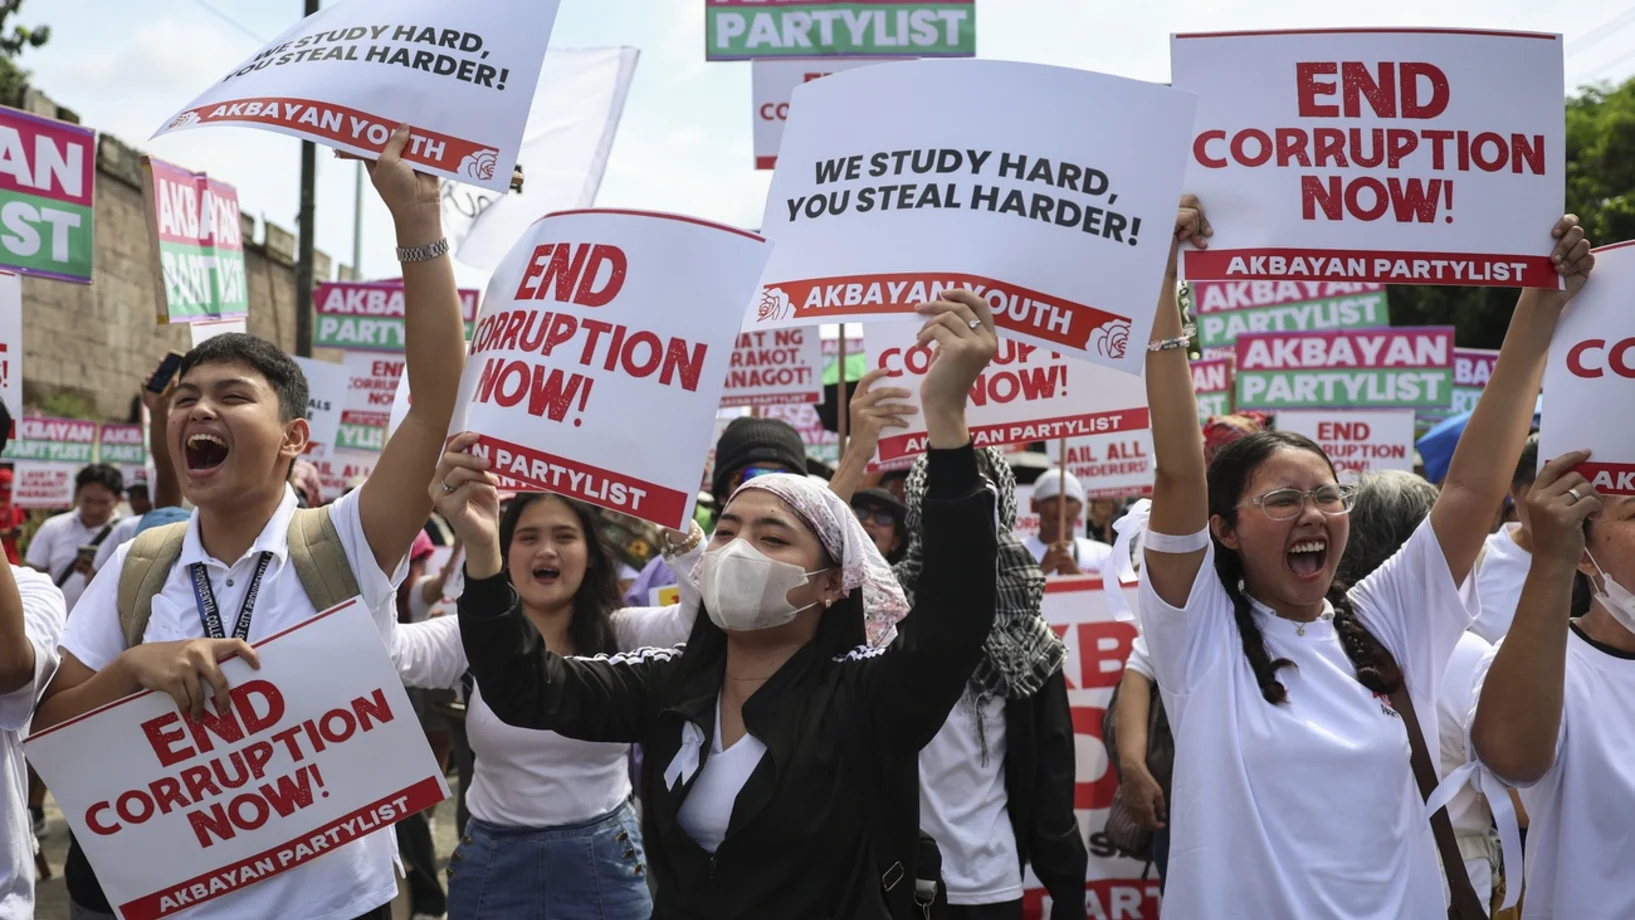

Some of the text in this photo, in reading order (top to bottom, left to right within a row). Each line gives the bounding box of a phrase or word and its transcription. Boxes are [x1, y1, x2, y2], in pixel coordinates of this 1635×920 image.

[256, 25, 490, 62] WE STUDY HARD,
[716, 9, 968, 48] PARTYLIST
[223, 45, 509, 91] YOU STEAL HARDER!
[1296, 61, 1450, 119] END
[208, 102, 446, 162] AKBAYAN YOTH
[1193, 127, 1545, 175] CORRUPTION
[815, 149, 1118, 205] WE STUDY HARD,
[1301, 175, 1453, 224] NOW!
[787, 183, 1142, 247] YOU STEAL HARDER!
[514, 242, 627, 307] END
[1226, 257, 1528, 281] AKBAYAN PARTYLIST
[803, 281, 956, 309] AKBAYAN
[775, 330, 803, 346] NG
[1204, 297, 1380, 342] PARTYLIST
[470, 310, 708, 392] CORRUPTION
[1243, 336, 1448, 368] AKBAYAN
[368, 392, 394, 404] NO
[472, 358, 594, 428] NOW!
[1243, 373, 1446, 402] PARTYLIST
[1010, 415, 1122, 440] PARTYLIST
[1107, 441, 1146, 460] ALL
[1318, 422, 1370, 440] END
[496, 448, 646, 510] PARTYLIST
[141, 679, 285, 768] END
[85, 688, 394, 835] CORRUPTION
[187, 763, 329, 848] NOW!
[160, 797, 408, 912] AKBAYAN PARTYLIST
